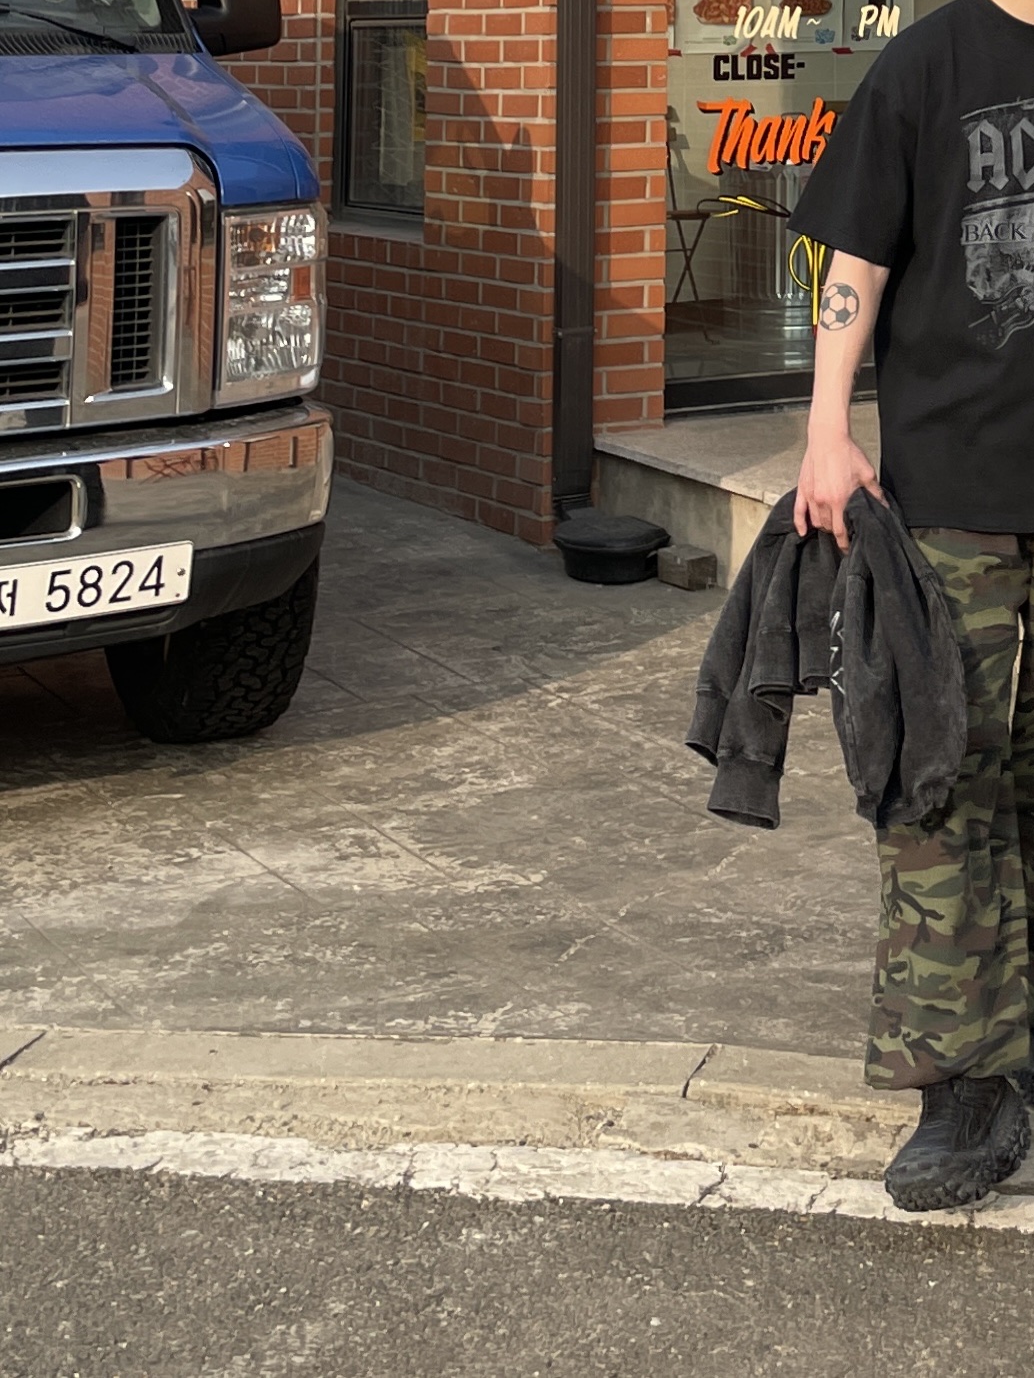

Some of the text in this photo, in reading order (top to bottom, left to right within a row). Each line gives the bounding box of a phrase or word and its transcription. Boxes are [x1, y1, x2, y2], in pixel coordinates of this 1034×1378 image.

[734, 5, 802, 40] 10AM
[858, 4, 900, 38] PM
[964, 223, 1026, 242] BACK
[46, 555, 165, 612] 5824
